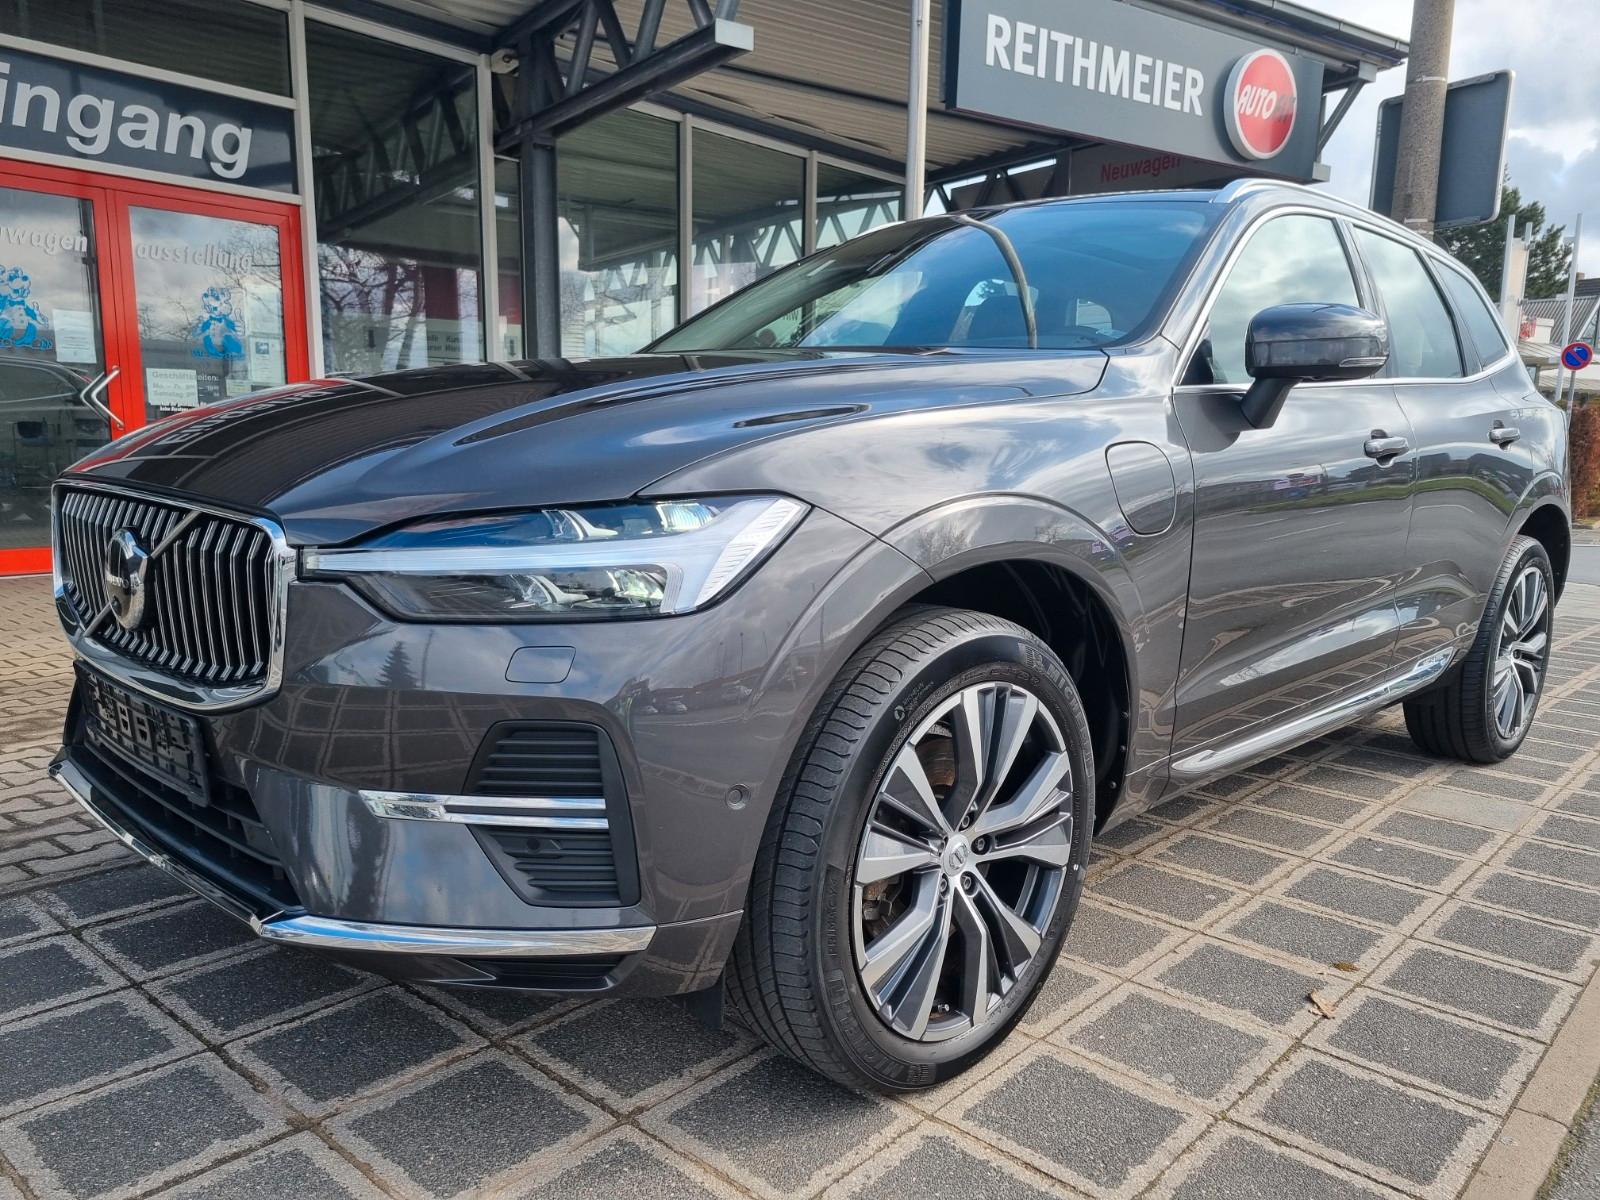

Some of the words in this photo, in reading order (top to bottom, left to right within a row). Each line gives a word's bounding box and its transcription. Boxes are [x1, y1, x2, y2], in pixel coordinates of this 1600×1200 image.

[985, 13, 1204, 116] REITHMEIER
[1100, 155, 1181, 182] Neuwagen
[0, 227, 88, 256] wagen
[136, 243, 253, 273] ausstellung
